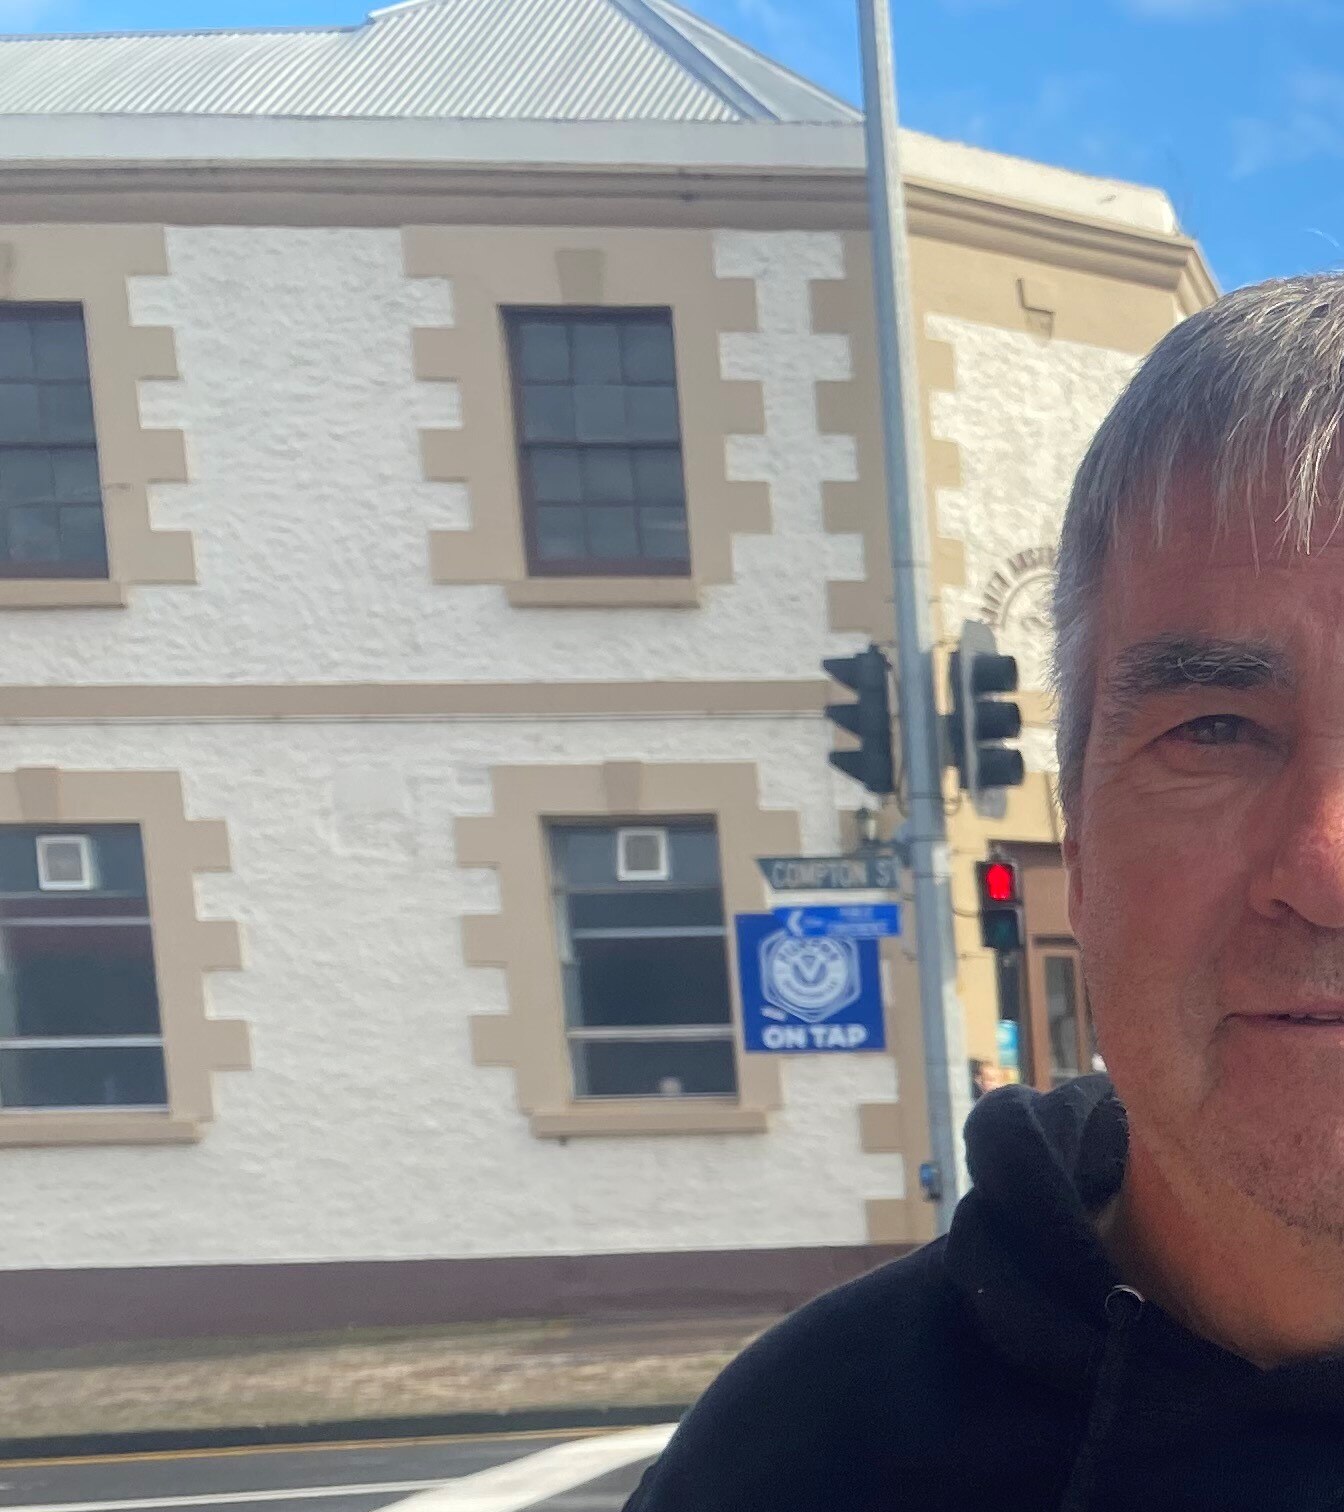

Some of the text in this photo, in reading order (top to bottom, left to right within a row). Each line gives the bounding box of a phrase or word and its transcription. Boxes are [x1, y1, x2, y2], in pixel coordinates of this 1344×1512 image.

[772, 860, 867, 888] COMPTON
[761, 1023, 868, 1049] ON TAP
